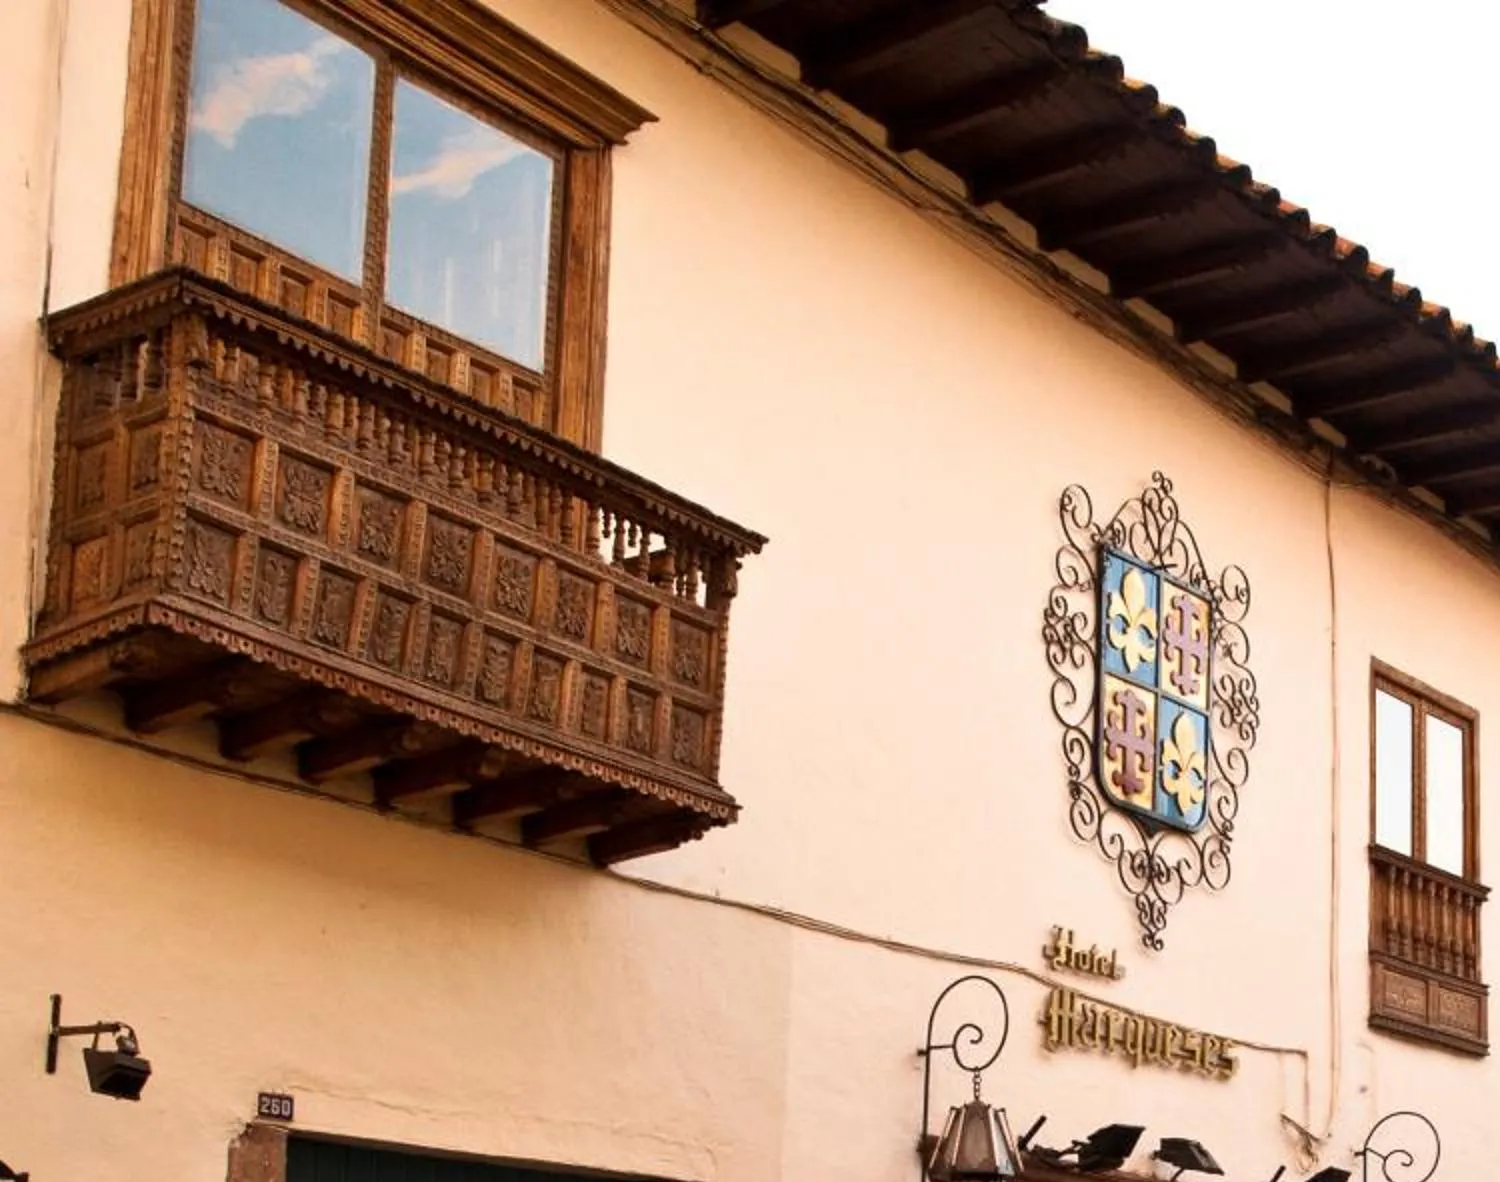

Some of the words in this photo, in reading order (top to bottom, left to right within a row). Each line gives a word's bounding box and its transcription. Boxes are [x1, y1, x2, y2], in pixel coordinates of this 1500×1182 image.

[1042, 925, 1125, 980] Hotel
[1038, 986, 1239, 1081] Marqueses
[259, 1096, 291, 1117] 260
